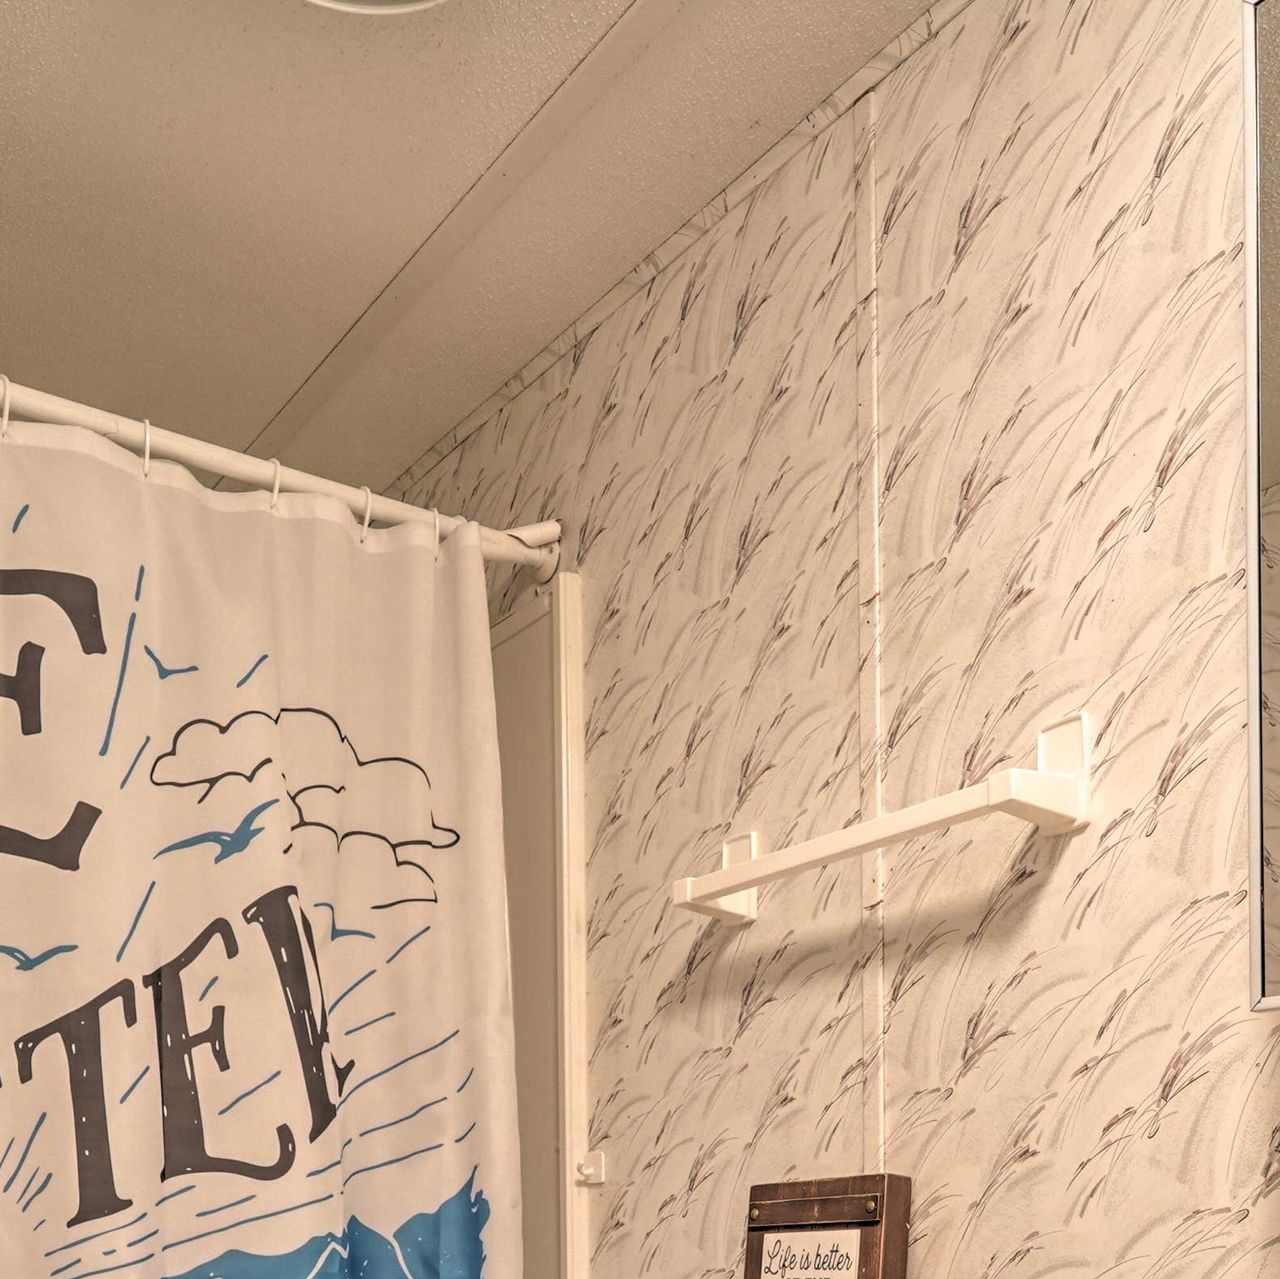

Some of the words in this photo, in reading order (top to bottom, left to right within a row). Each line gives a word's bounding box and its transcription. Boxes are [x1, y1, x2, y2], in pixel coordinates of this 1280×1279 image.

[764, 1240, 797, 1279] Life
[800, 1248, 812, 1270] is
[814, 1243, 853, 1271] better
